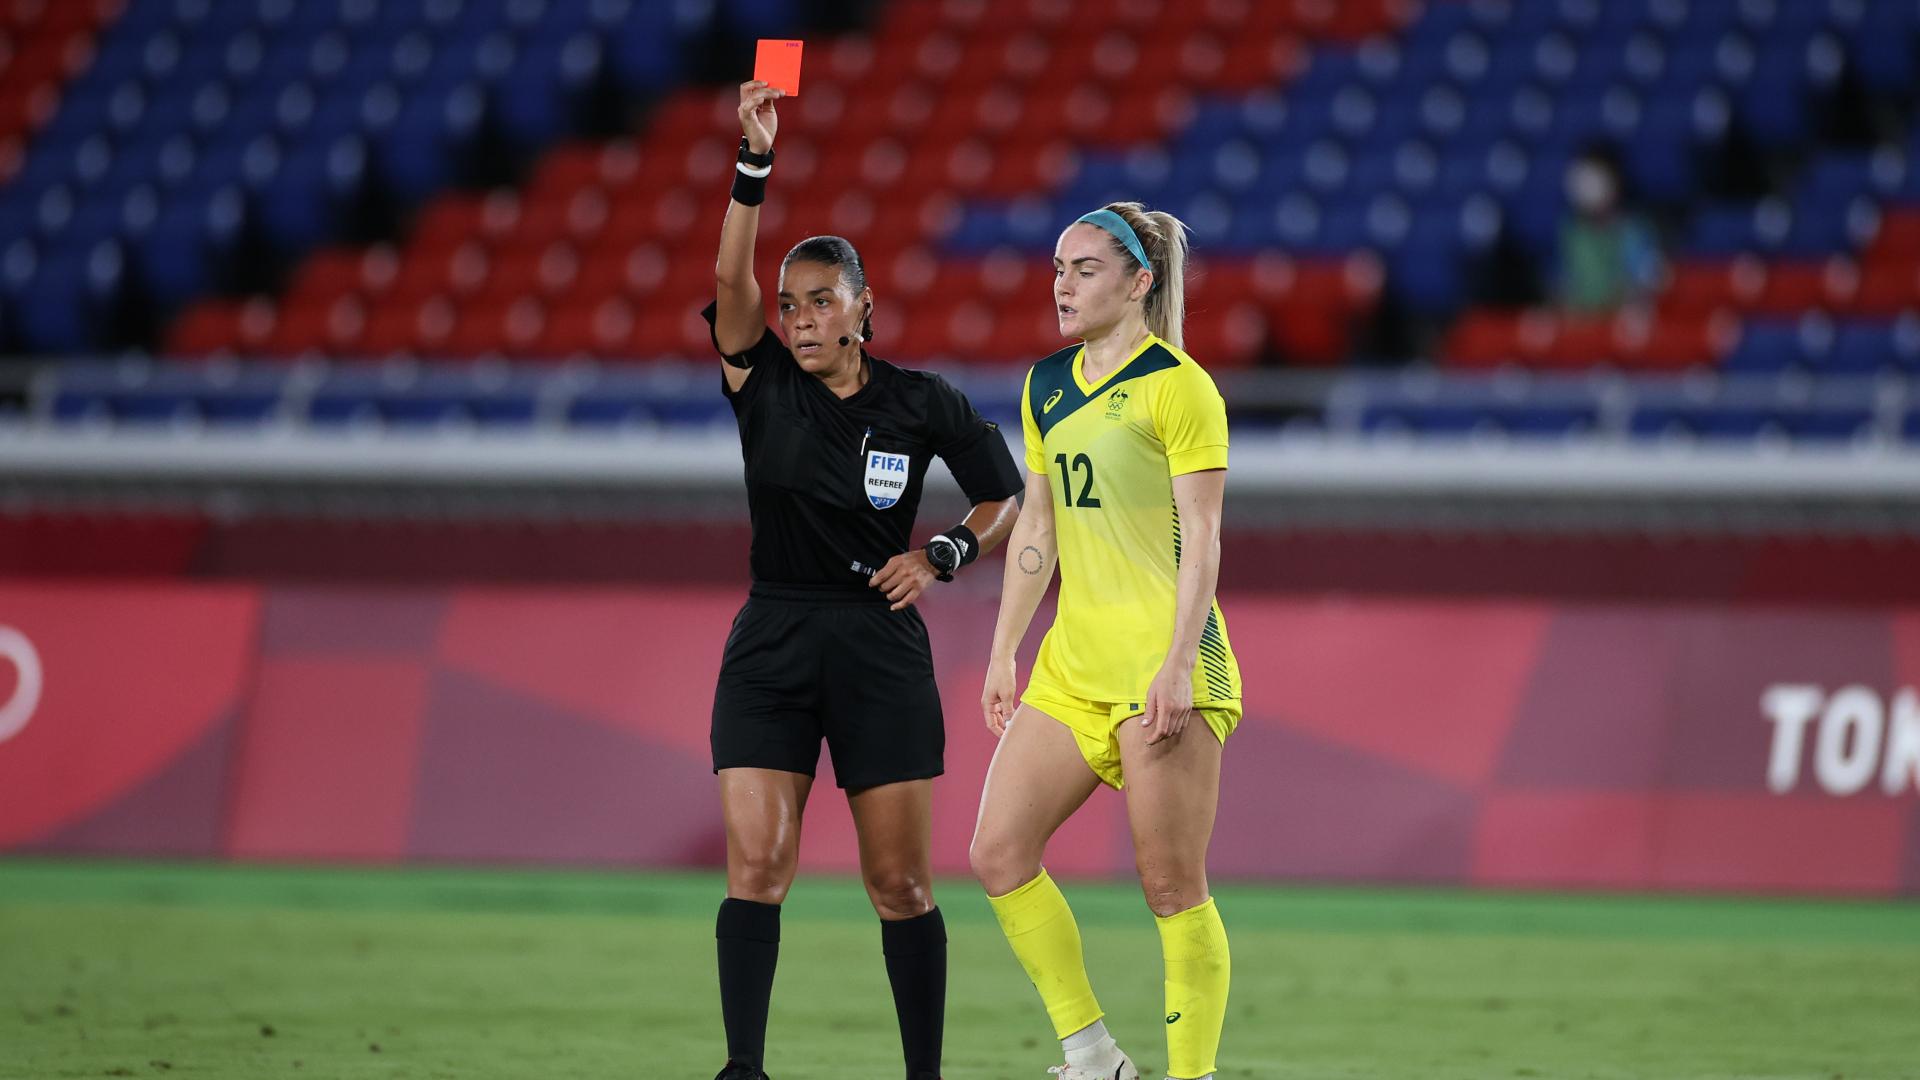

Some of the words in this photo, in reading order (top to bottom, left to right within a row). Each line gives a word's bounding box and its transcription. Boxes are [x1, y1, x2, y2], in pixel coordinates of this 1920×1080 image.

[871, 455, 905, 473] FIFA
[868, 478, 903, 489] REFEREE
[1055, 453, 1101, 508] 12
